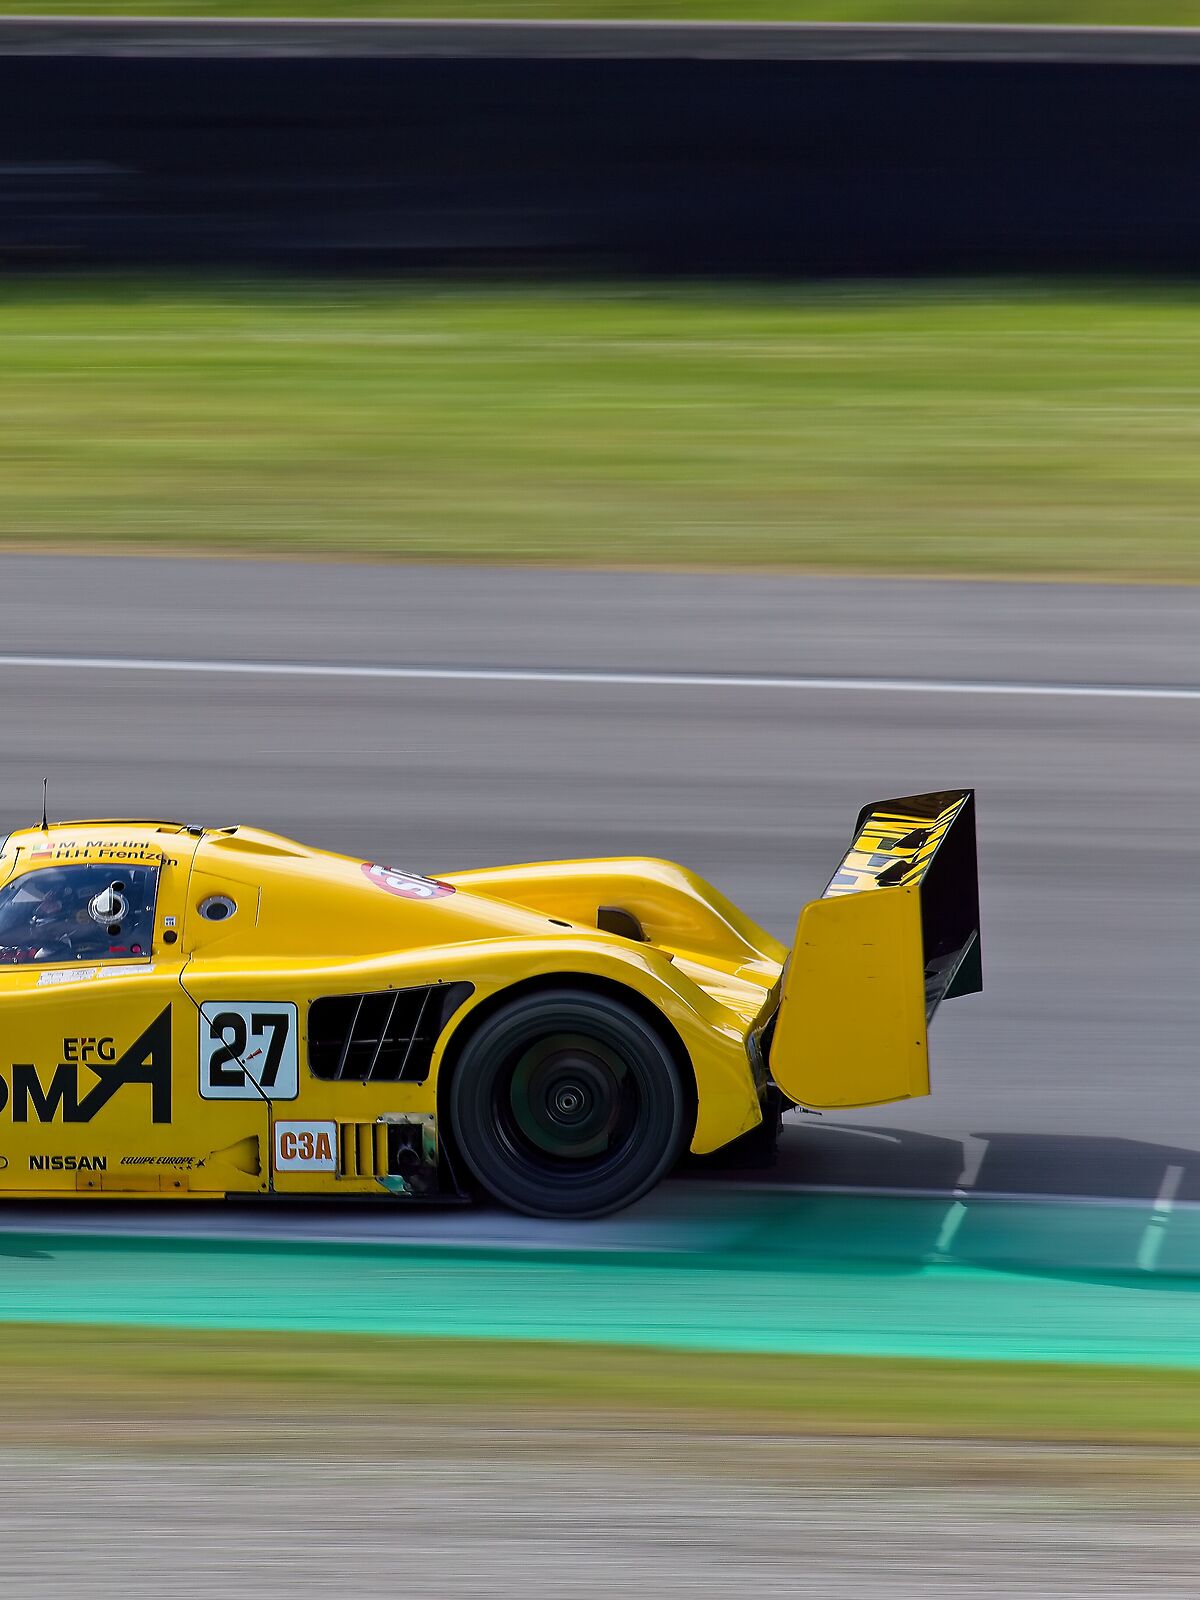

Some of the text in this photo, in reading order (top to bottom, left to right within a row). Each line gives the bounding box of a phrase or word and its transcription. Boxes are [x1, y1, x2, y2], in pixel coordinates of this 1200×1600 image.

[58, 840, 150, 849] M. Martini
[56, 849, 178, 867] H.H. Frentzen
[63, 1037, 116, 1062] EFG
[209, 1012, 289, 1087] 27
[280, 1131, 332, 1160] C3A
[29, 1155, 107, 1171] NISSAN
[120, 1156, 195, 1165] EQUIPE EUROPE
